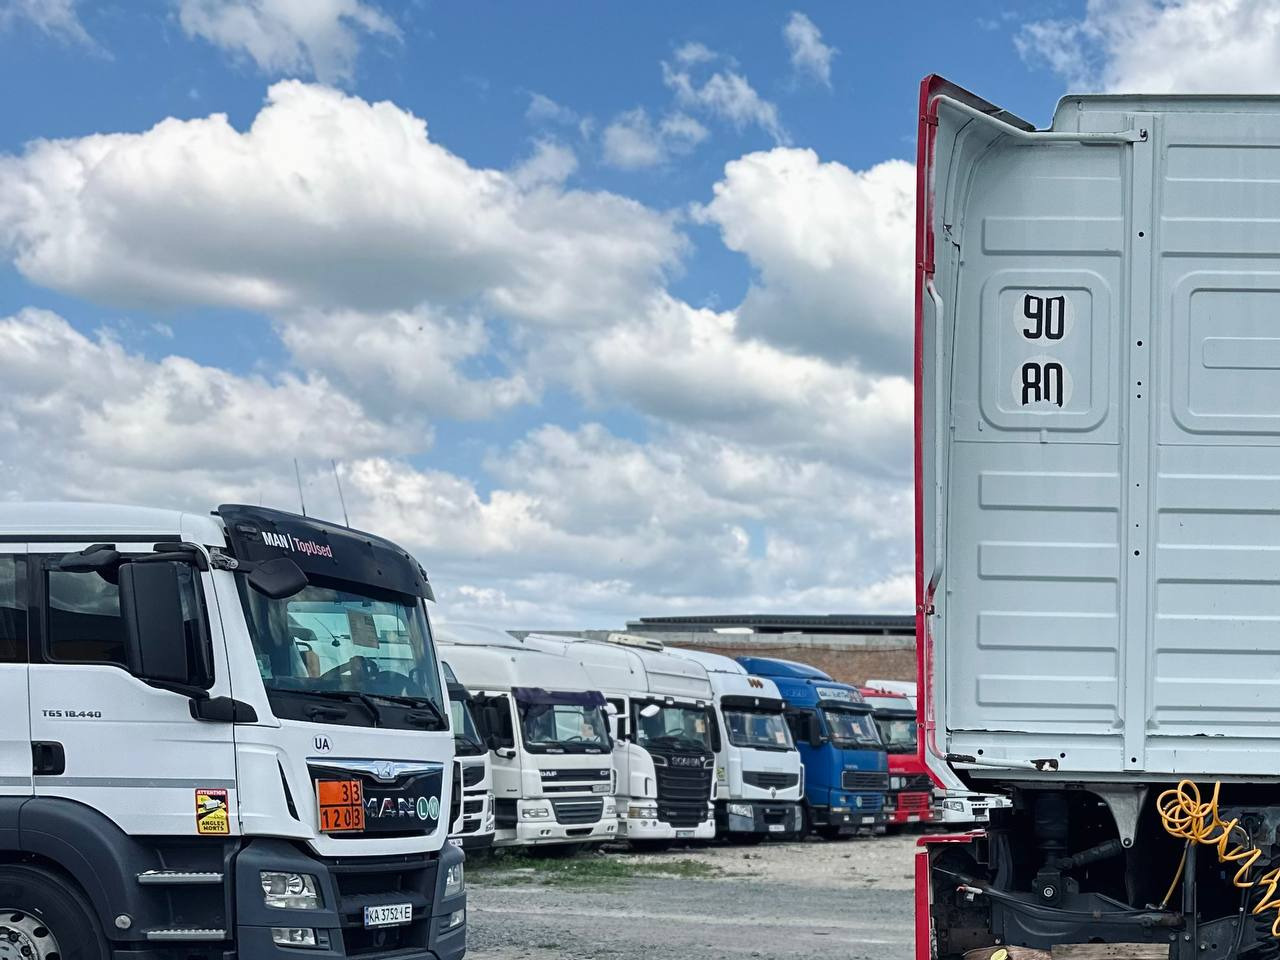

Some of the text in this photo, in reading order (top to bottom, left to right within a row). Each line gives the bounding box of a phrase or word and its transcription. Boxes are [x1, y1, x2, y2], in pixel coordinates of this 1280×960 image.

[1022, 293, 1066, 341] 90
[1021, 362, 1064, 408] 80
[262, 531, 333, 558] MAN TopUsed
[41, 709, 102, 718] TGS 18.440
[314, 738, 330, 750] UA
[341, 783, 360, 803] 33
[321, 807, 361, 829] 1203
[363, 797, 415, 818] MAN
[369, 909, 380, 922] KA
[381, 907, 399, 921] 3752
